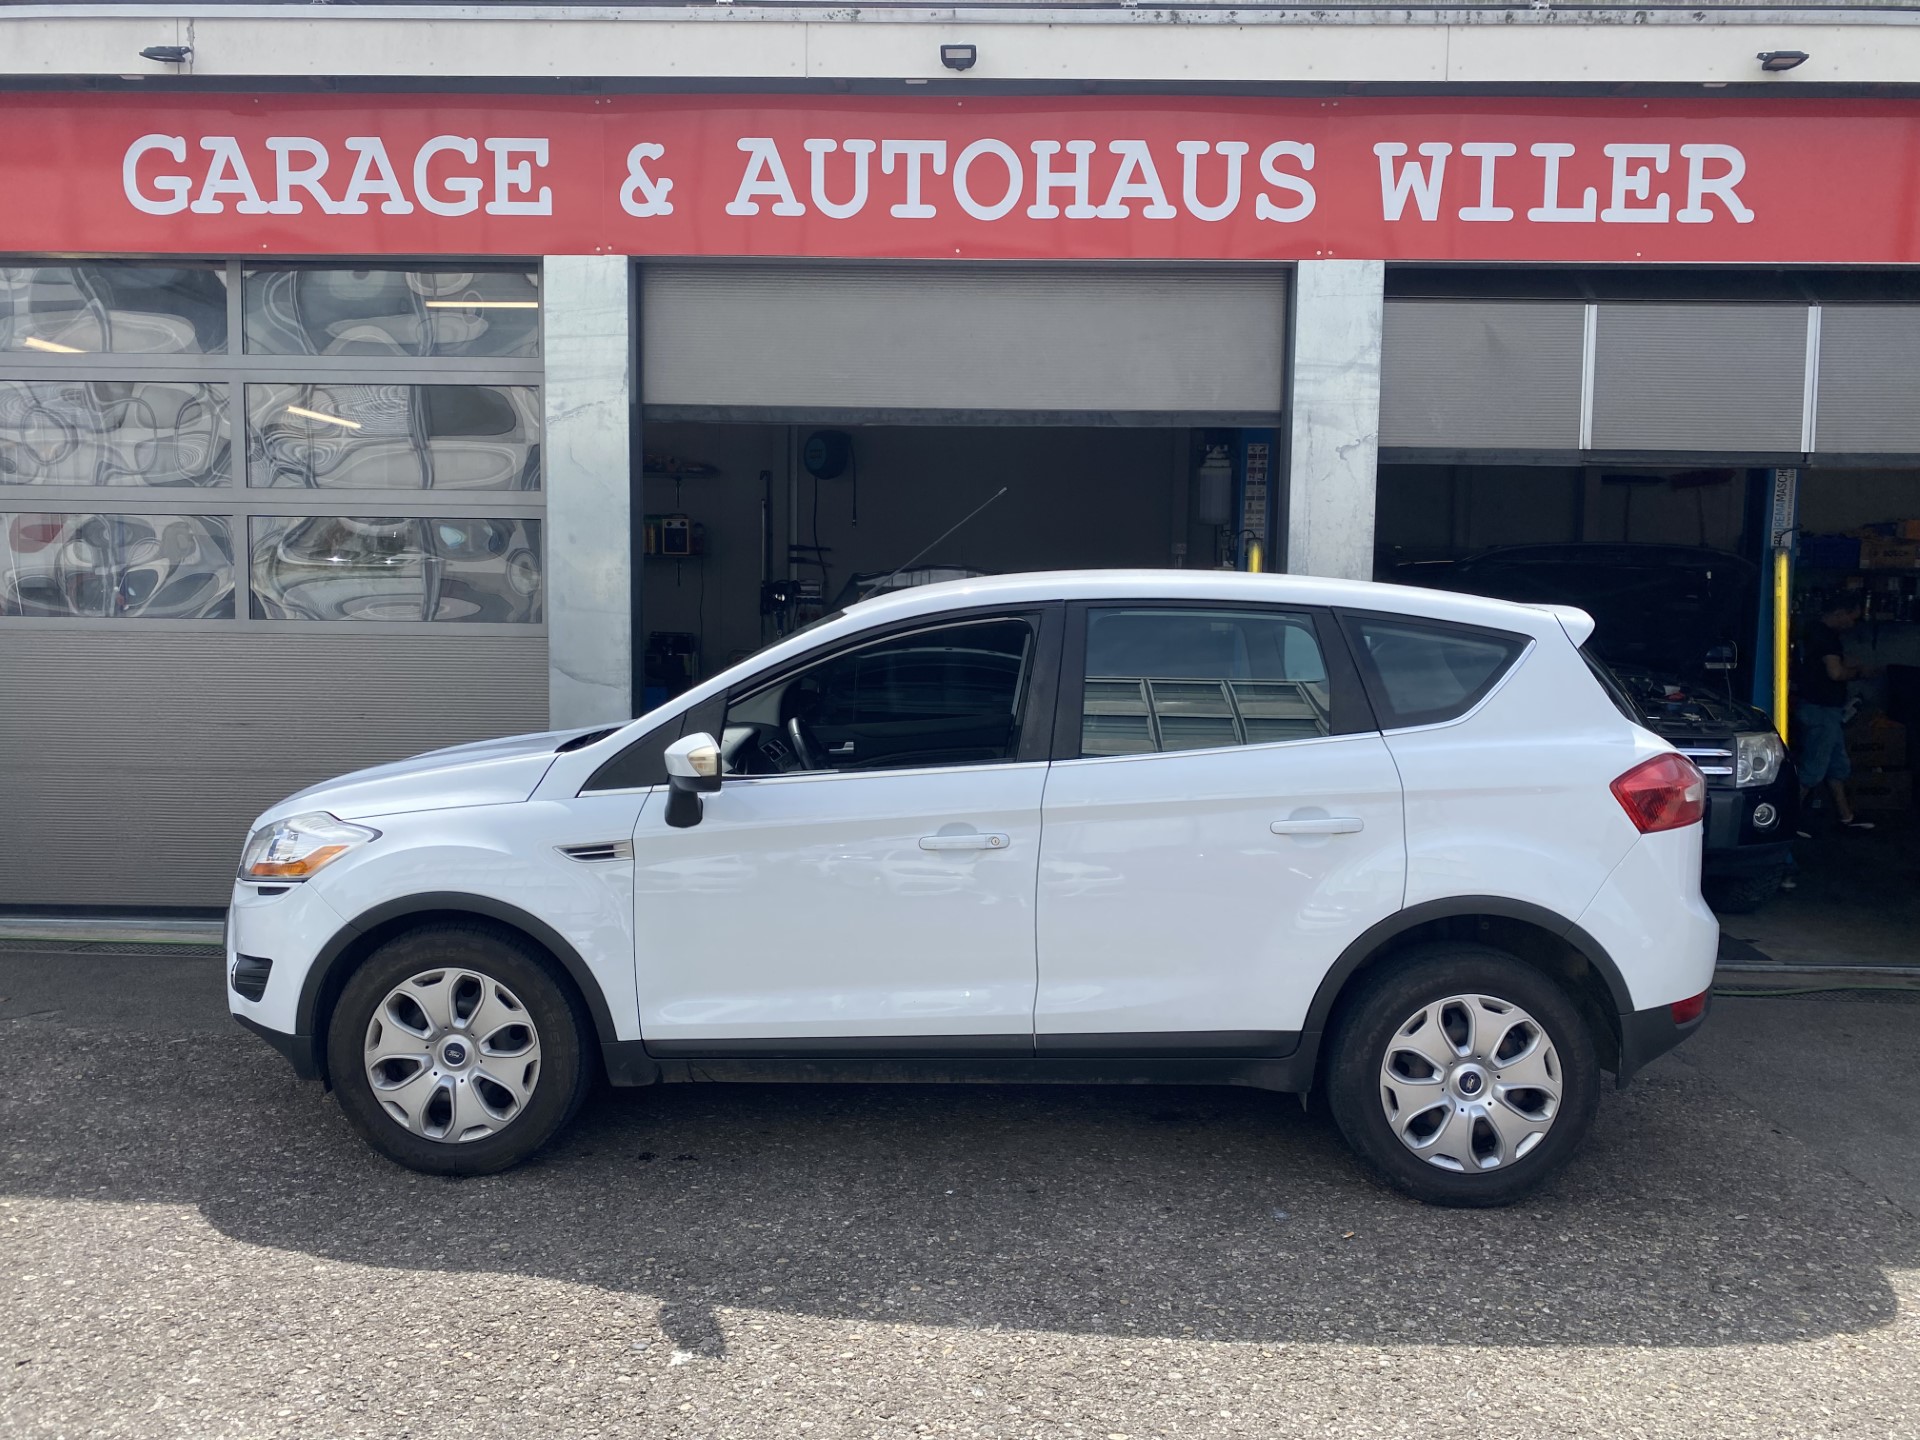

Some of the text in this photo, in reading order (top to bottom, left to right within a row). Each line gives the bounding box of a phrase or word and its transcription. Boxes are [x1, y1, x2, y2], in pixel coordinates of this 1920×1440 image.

[123, 134, 1754, 223] GARAGE & AUTOHAUS WILER
